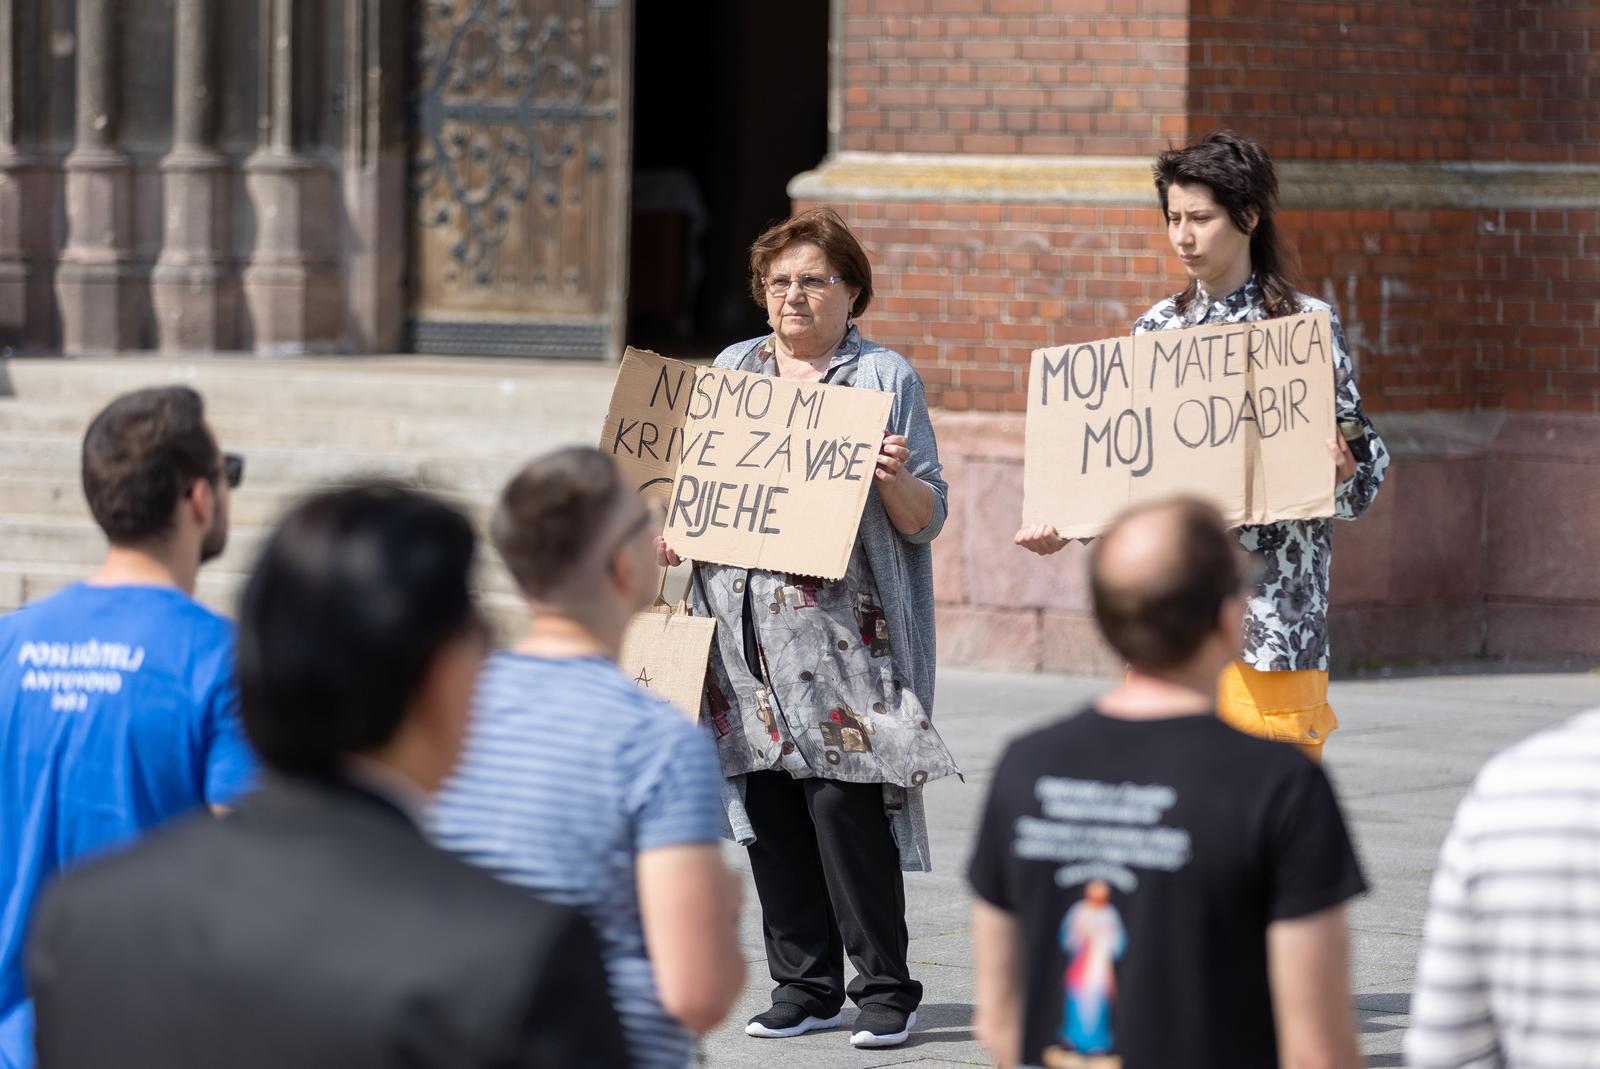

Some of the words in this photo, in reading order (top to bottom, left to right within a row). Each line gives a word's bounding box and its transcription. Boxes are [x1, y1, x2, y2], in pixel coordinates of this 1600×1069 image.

[650, 364, 773, 420] NISMO
[786, 387, 826, 430] MI
[1041, 341, 1129, 410] MOJA
[1150, 318, 1326, 393] MATERNICA
[613, 417, 725, 467] KRIVE
[735, 431, 792, 473] ZA
[804, 435, 872, 482] VAŠE
[1081, 407, 1154, 477] MOJ
[1173, 378, 1310, 449] ODABIR
